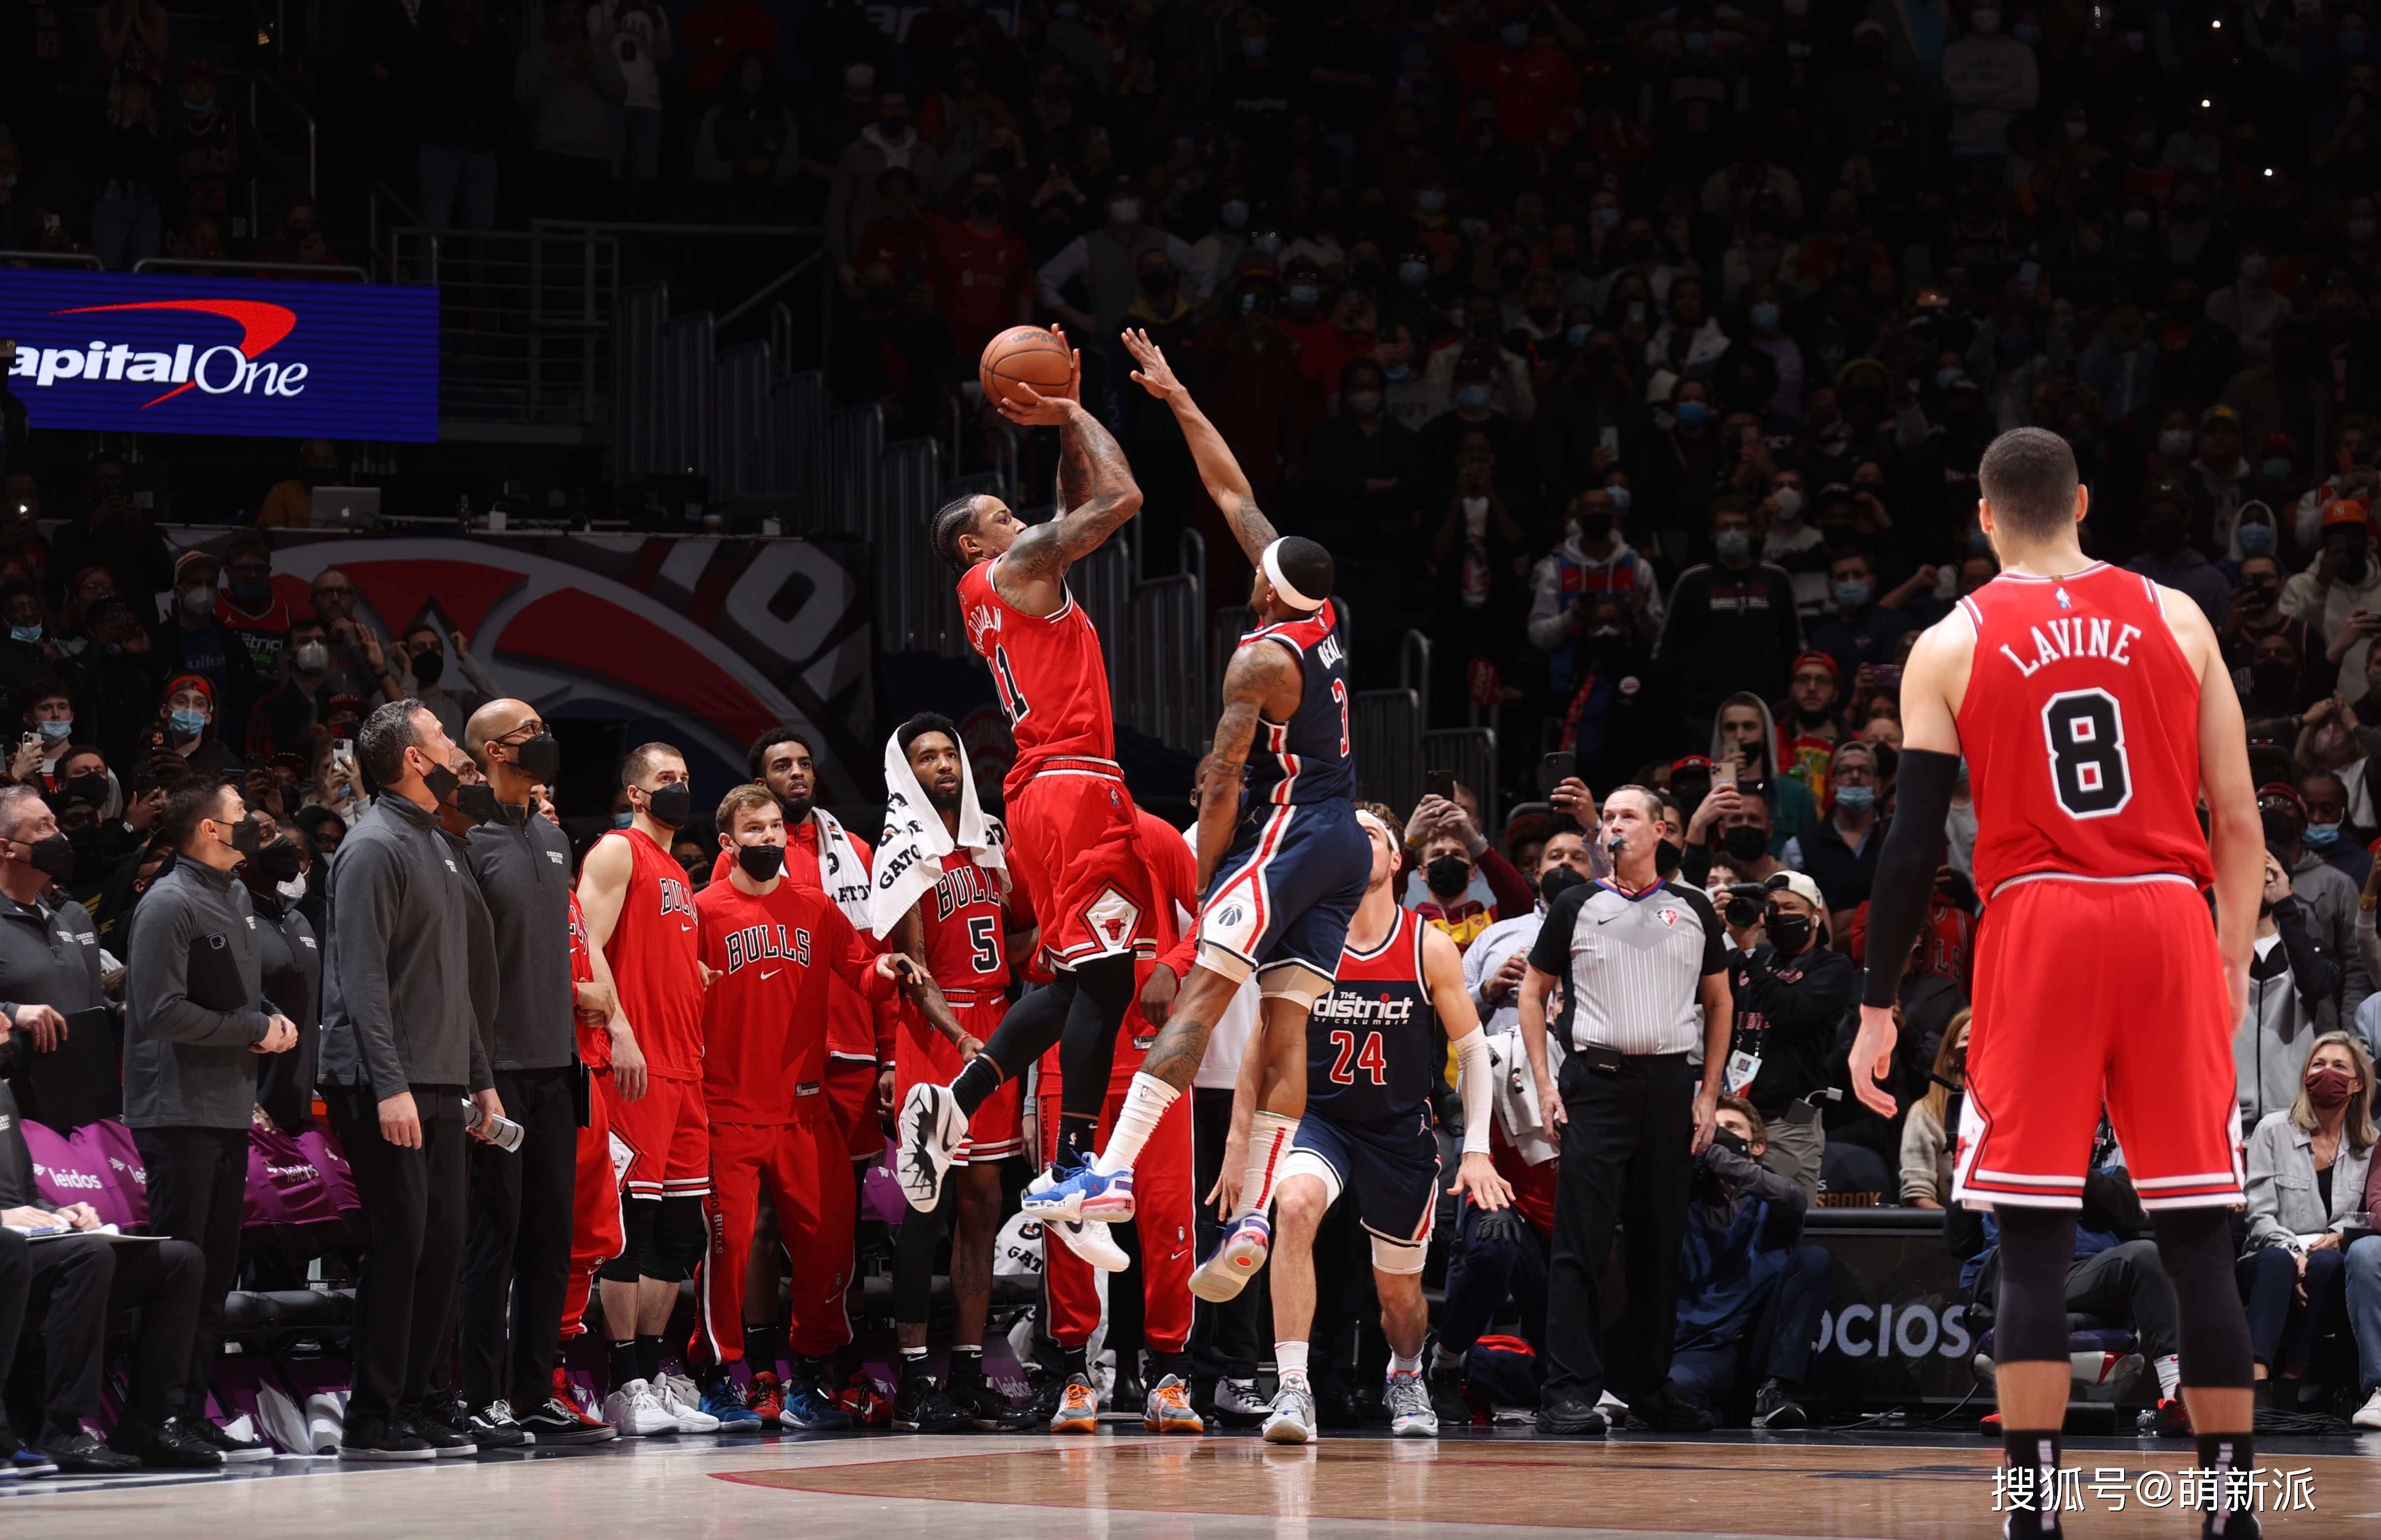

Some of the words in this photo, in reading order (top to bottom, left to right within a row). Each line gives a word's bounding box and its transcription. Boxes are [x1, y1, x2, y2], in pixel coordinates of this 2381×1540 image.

[8, 340, 195, 387] apital
[195, 345, 309, 397] One
[1316, 633, 1343, 670] BEAL
[1999, 617, 2142, 678] LAVINE
[1330, 677, 1350, 759] 3
[2041, 686, 2133, 821] 8
[546, 851, 563, 860] CHICAGO
[659, 877, 699, 927] BULL
[936, 865, 1002, 923] BULL
[724, 924, 811, 975] BULLS
[967, 915, 1001, 974] 5
[1313, 989, 1413, 1019] district
[1340, 991, 1357, 1000] THE
[1329, 1030, 1388, 1085] 24
[49, 1166, 102, 1189] leidos
[128, 1166, 148, 1185] lei
[283, 1161, 319, 1184] leidos
[712, 1212, 725, 1255] BULLS
